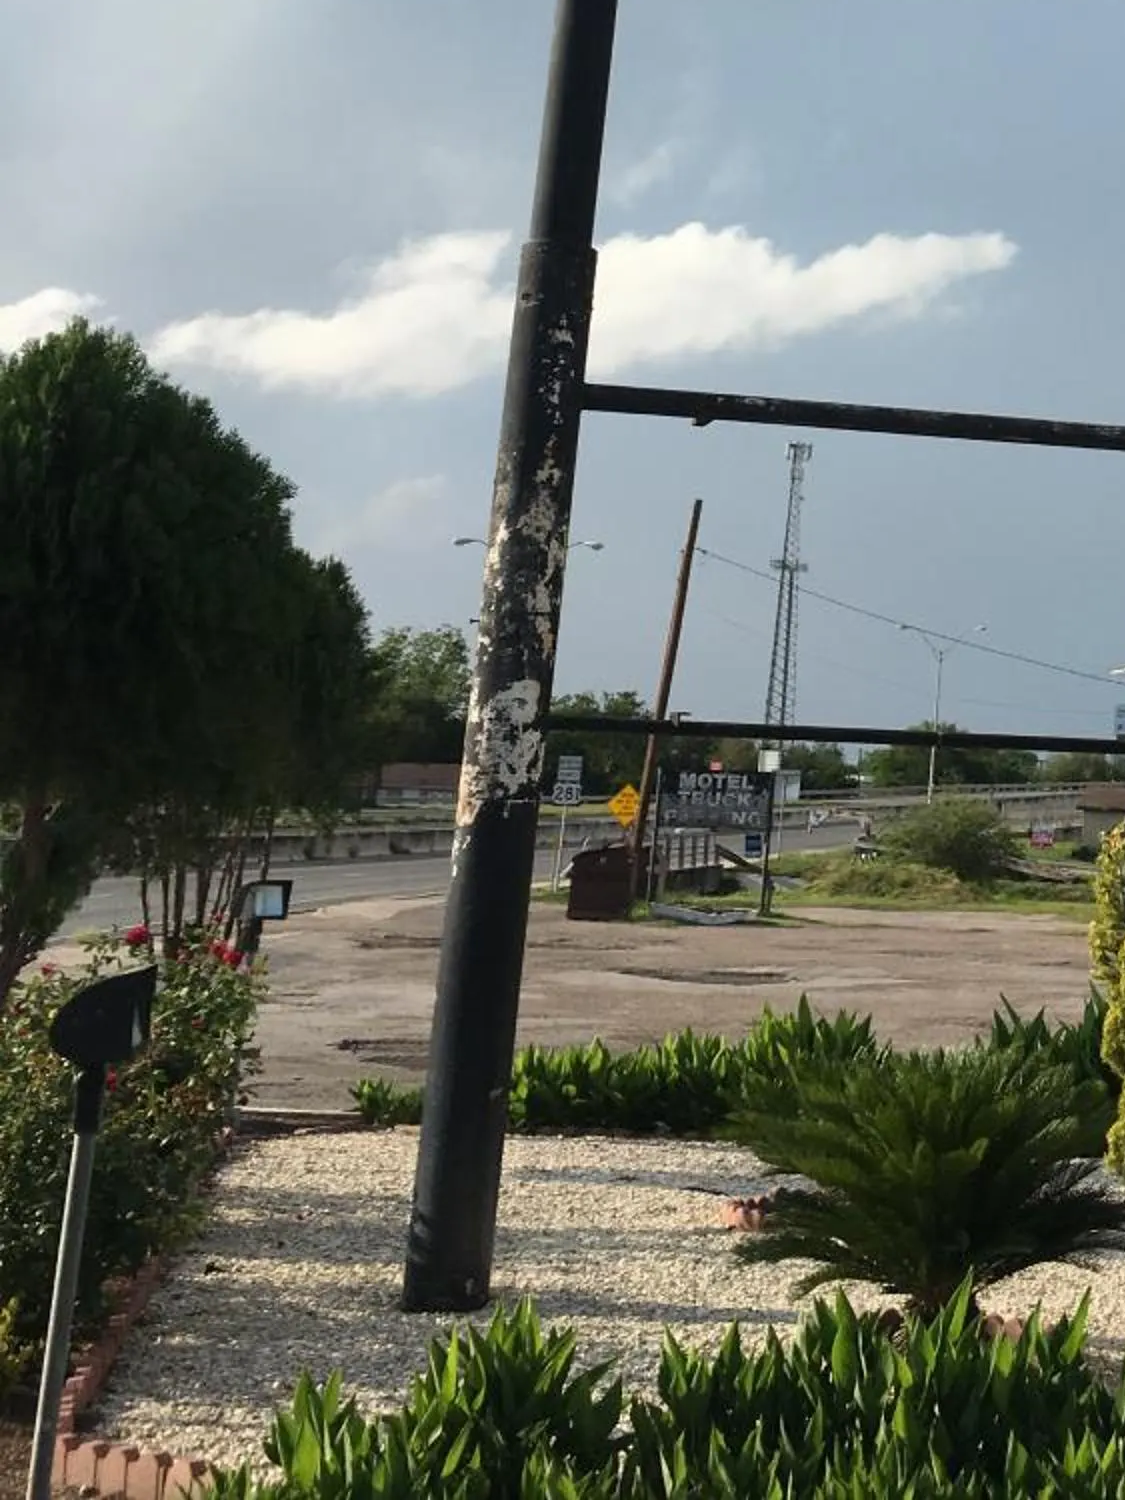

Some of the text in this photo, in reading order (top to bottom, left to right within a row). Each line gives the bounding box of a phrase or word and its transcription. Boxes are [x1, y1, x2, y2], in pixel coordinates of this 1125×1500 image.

[679, 771, 754, 791] MOTEL
[555, 786, 580, 801] 281
[677, 789, 752, 807] TRUCK
